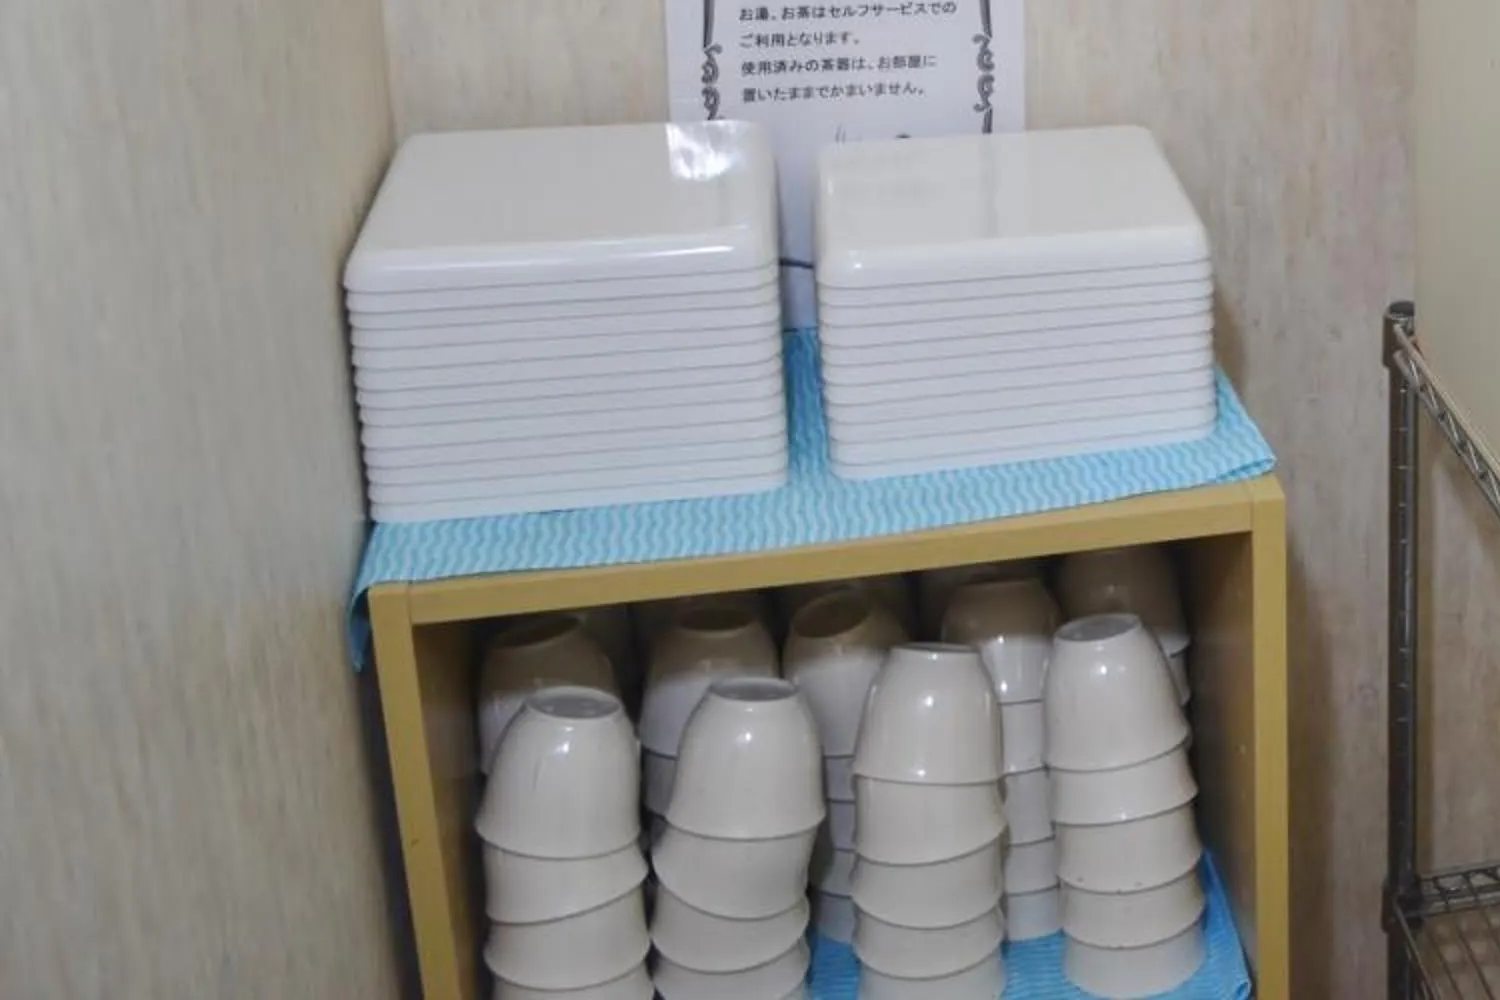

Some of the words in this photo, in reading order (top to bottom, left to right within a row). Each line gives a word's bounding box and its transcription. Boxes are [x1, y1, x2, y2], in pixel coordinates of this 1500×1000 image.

[738, 0, 958, 22] お湯、お茶はセルフサービスでの
[739, 31, 861, 48] ご利用となります。
[740, 55, 937, 77] 使用済みの茶器は、お部屋に
[741, 83, 926, 104] 置いたままでかまいません。
